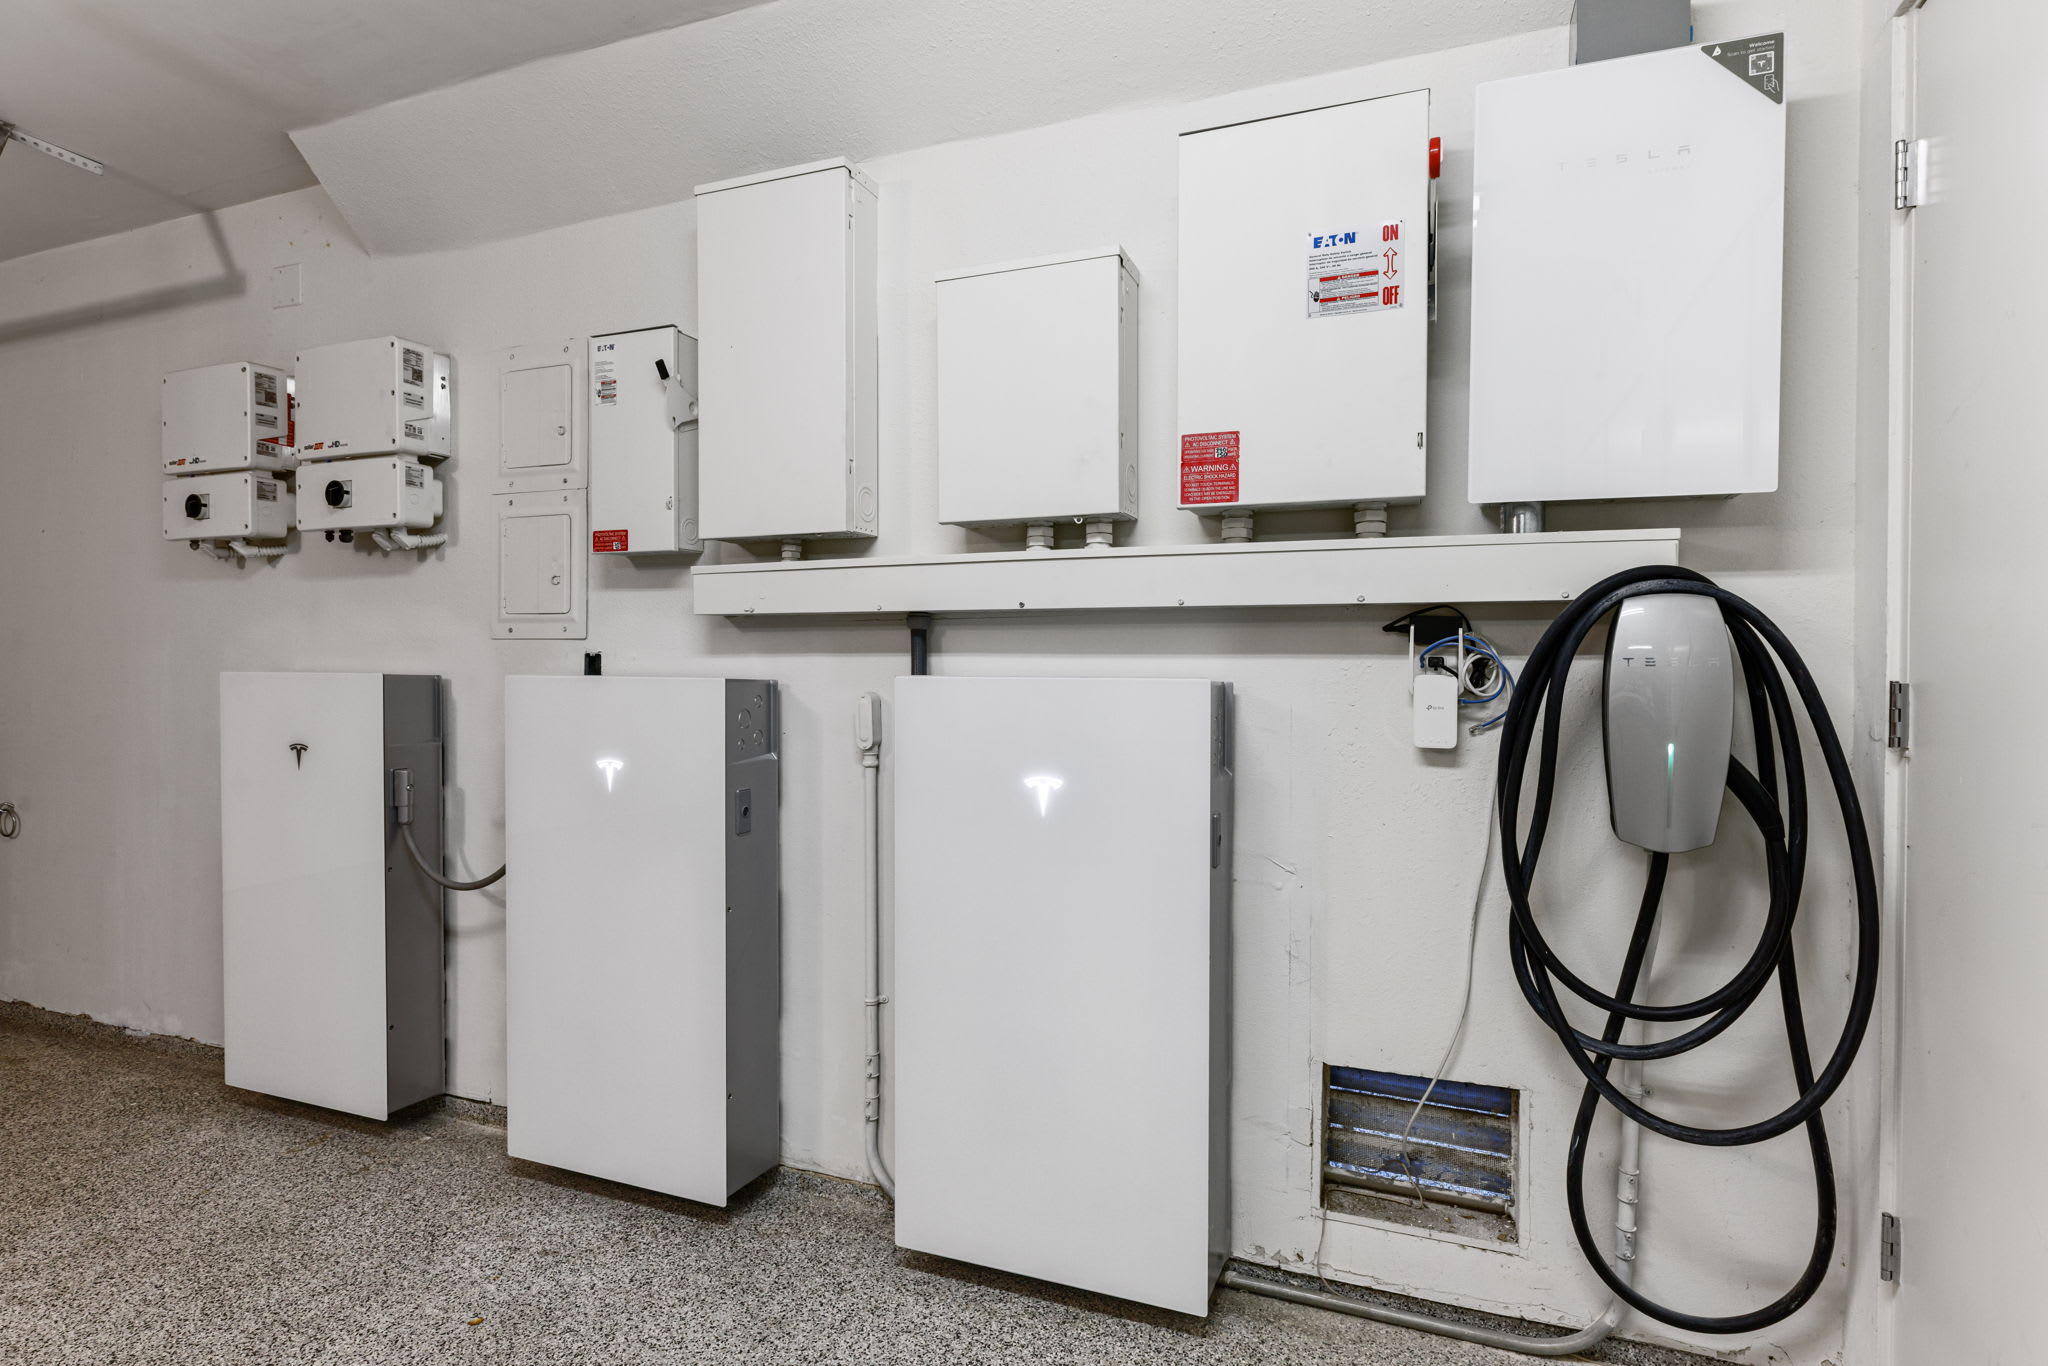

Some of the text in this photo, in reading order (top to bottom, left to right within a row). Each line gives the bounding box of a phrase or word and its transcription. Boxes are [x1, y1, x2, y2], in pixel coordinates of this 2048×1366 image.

[1749, 40, 1774, 48] Welcome
[1557, 144, 1691, 172] TESLA
[1314, 232, 1356, 248] EATON
[1382, 224, 1398, 242] ON
[1382, 285, 1400, 305] OFF
[1191, 464, 1228, 472] WARNING
